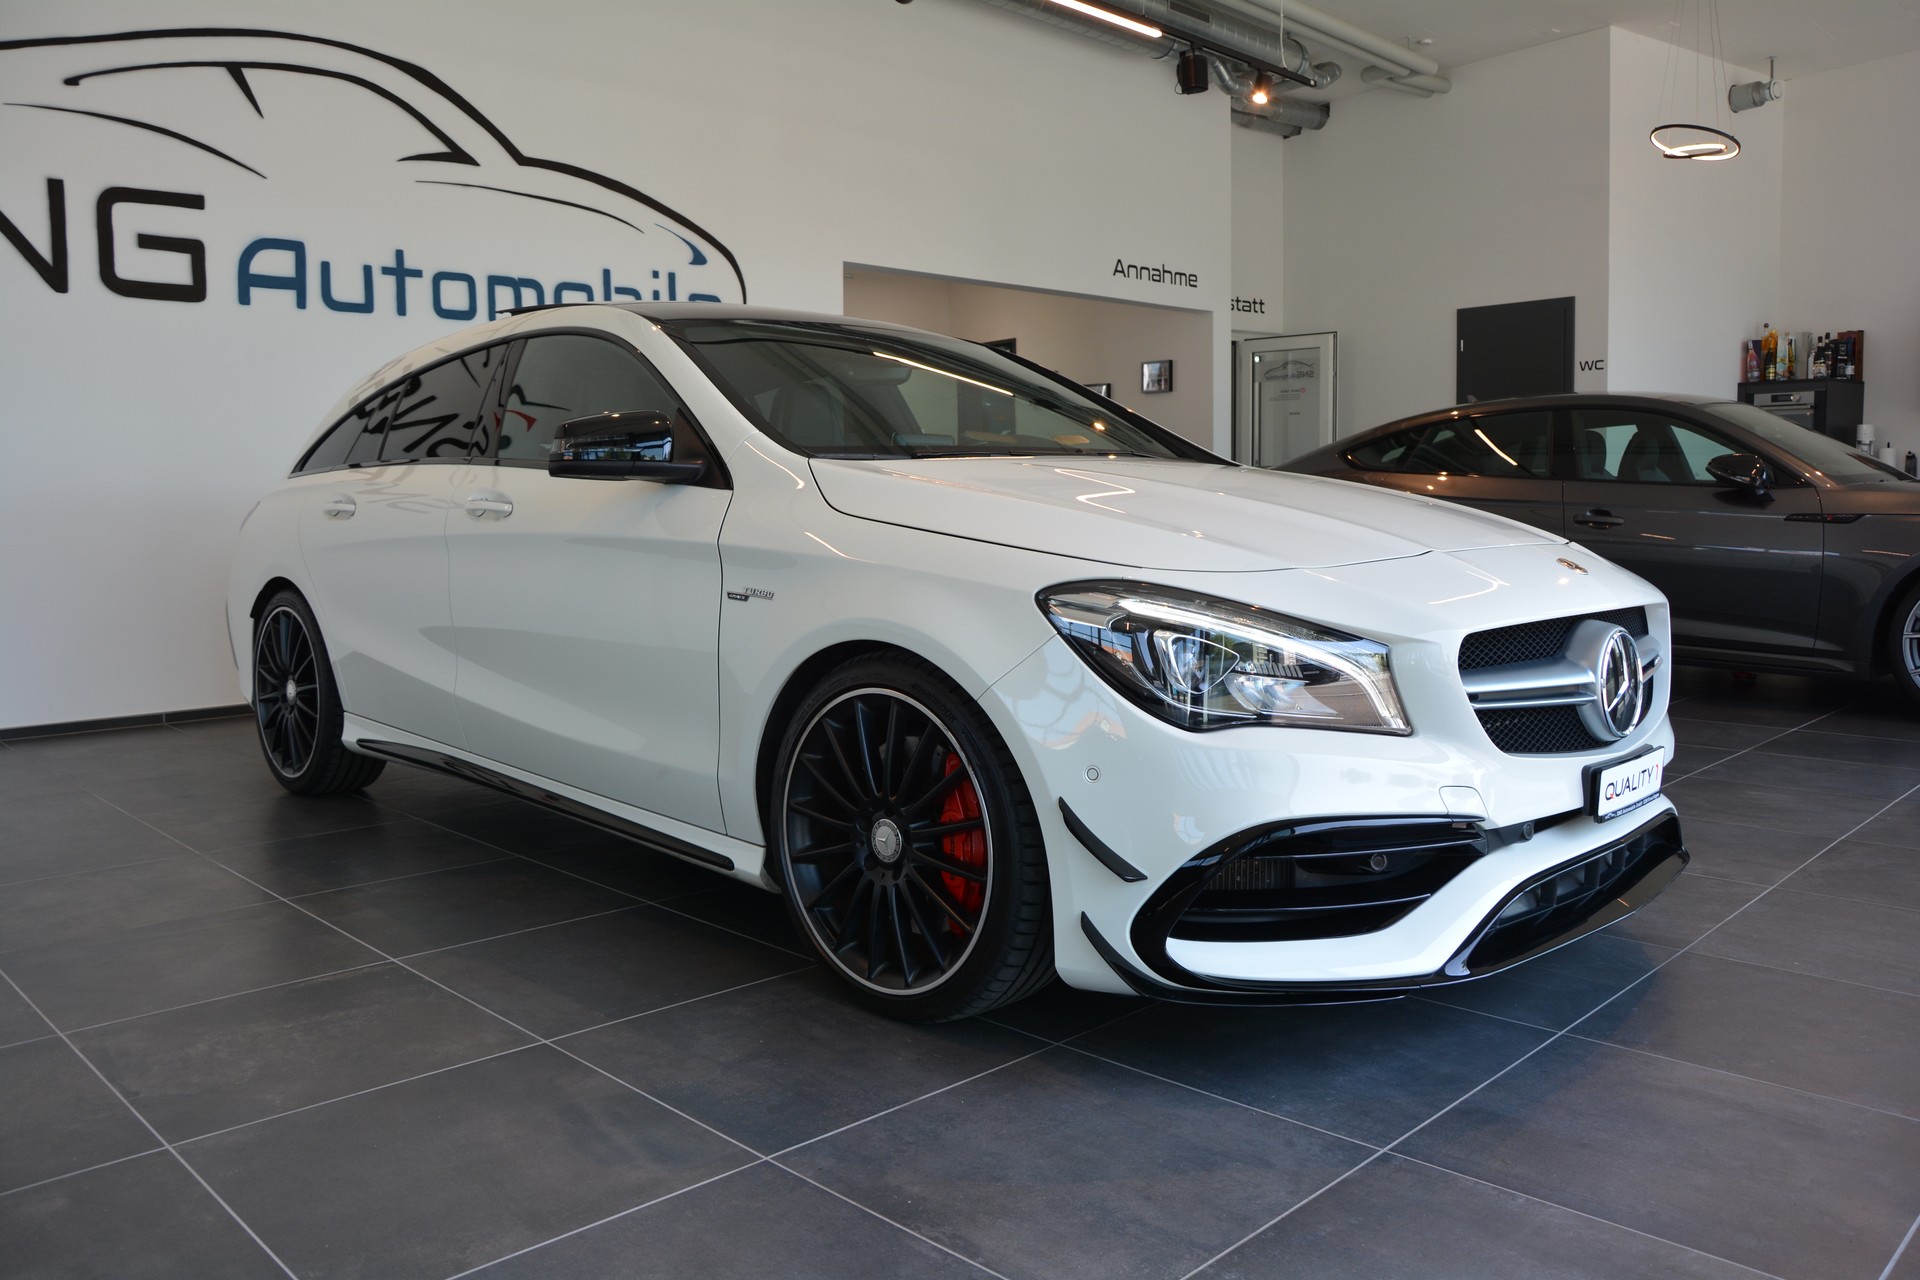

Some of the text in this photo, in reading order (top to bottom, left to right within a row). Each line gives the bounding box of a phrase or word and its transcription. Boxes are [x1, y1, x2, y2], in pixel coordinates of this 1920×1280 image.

[237, 238, 722, 322] Automobil
[1113, 258, 1198, 288] Annahme
[1579, 359, 1605, 372] WC
